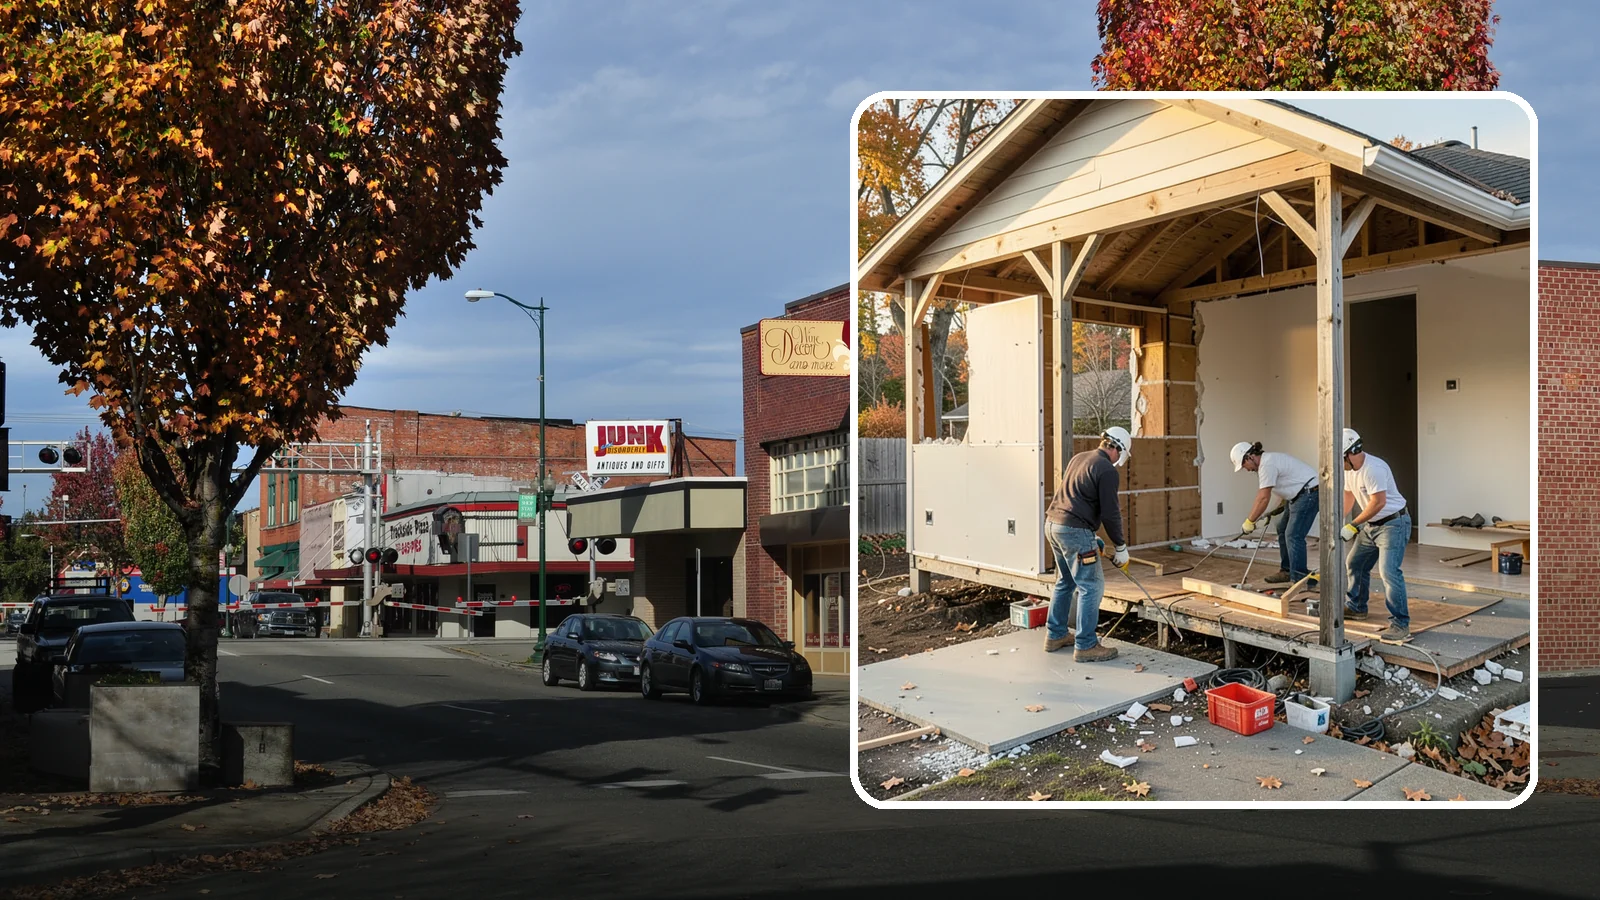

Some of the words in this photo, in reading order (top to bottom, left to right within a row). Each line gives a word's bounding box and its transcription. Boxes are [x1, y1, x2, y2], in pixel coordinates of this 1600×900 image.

[595, 425, 665, 457] JUNK
[607, 446, 646, 454] DISORDERLY
[597, 461, 628, 470] ANTIQUES
[631, 461, 643, 470] AND
[647, 460, 665, 469] GIFTS
[390, 521, 413, 540] Trackside
[414, 519, 429, 535] Pizza
